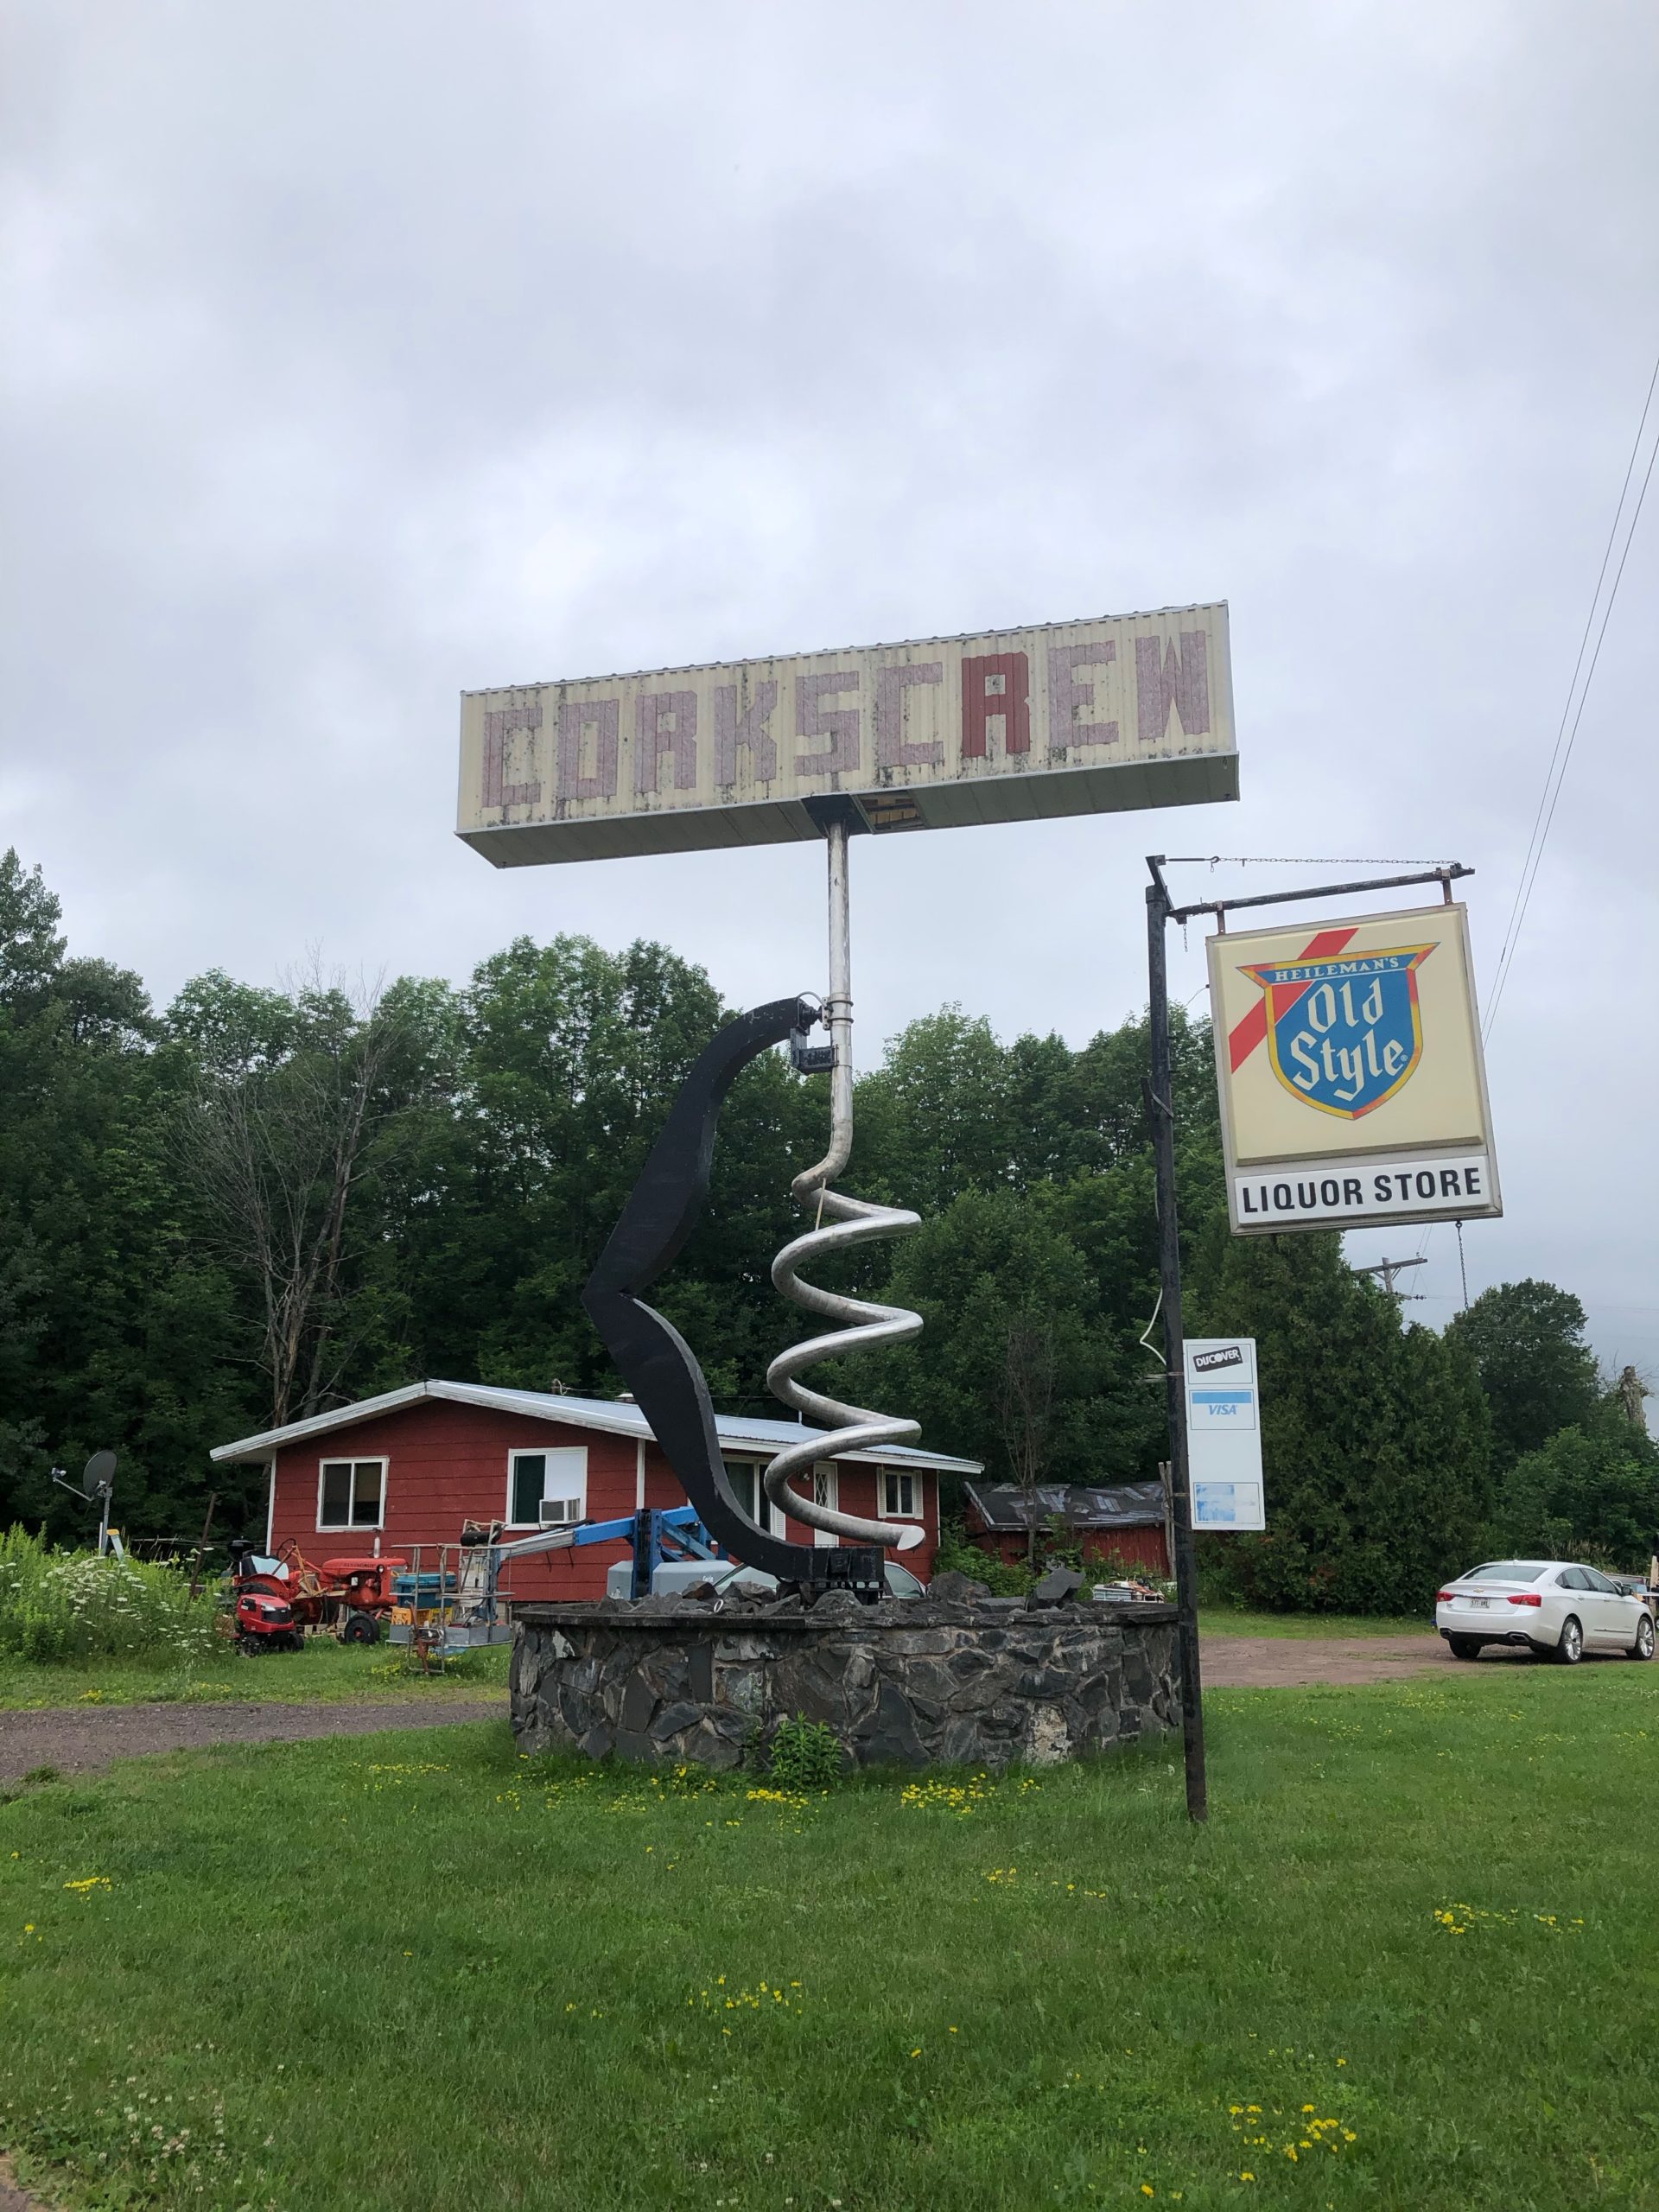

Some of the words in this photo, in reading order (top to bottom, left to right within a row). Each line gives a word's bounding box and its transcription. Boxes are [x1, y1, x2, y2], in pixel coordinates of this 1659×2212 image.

[481, 630, 1211, 808] CORKSCREW
[1274, 957, 1400, 982] HEILEMAN'S
[1307, 976, 1383, 1034] Old
[1290, 1028, 1404, 1102] Style
[1243, 1178, 1363, 1213] LIQUOR
[1374, 1167, 1482, 1203] STORE
[1195, 1349, 1239, 1368] DISCOVER
[1208, 1404, 1237, 1415] VISA
